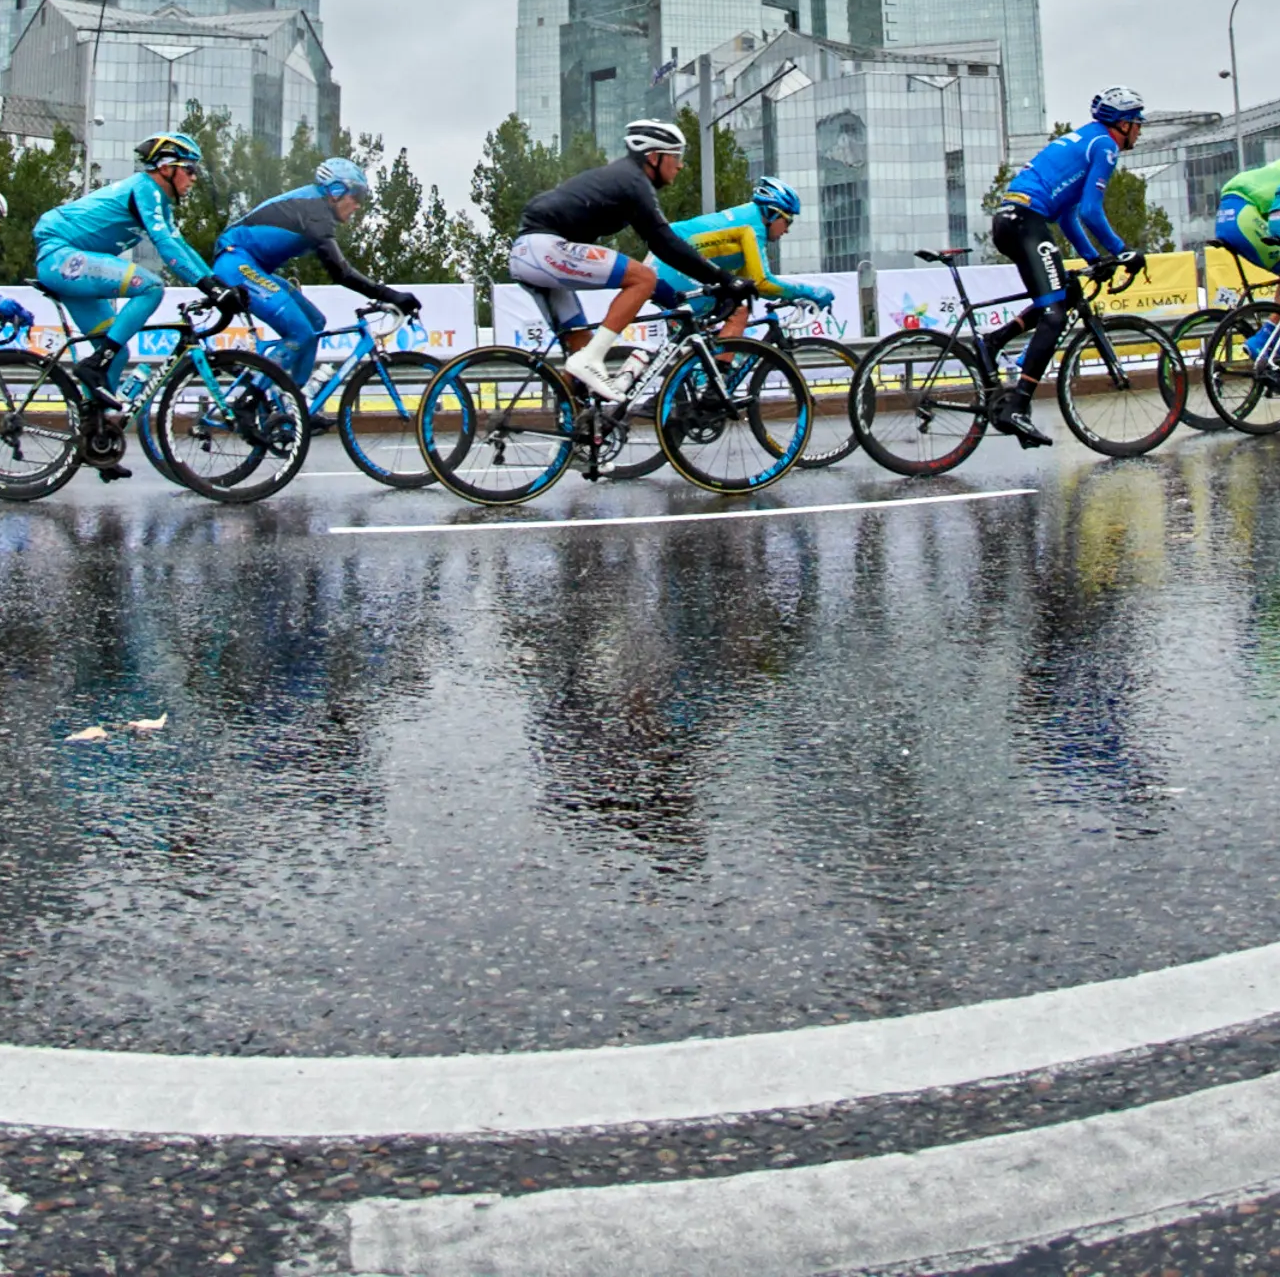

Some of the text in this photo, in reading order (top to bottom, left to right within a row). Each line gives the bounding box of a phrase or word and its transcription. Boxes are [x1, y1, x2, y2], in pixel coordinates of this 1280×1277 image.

[940, 302, 955, 313] 26
[1110, 299, 1129, 311] OF
[1136, 294, 1188, 307] ALMATY
[527, 328, 543, 340] 52
[45, 339, 53, 349] 2
[627, 341, 677, 401] CARRERA
[124, 354, 178, 418] S-WORKS
